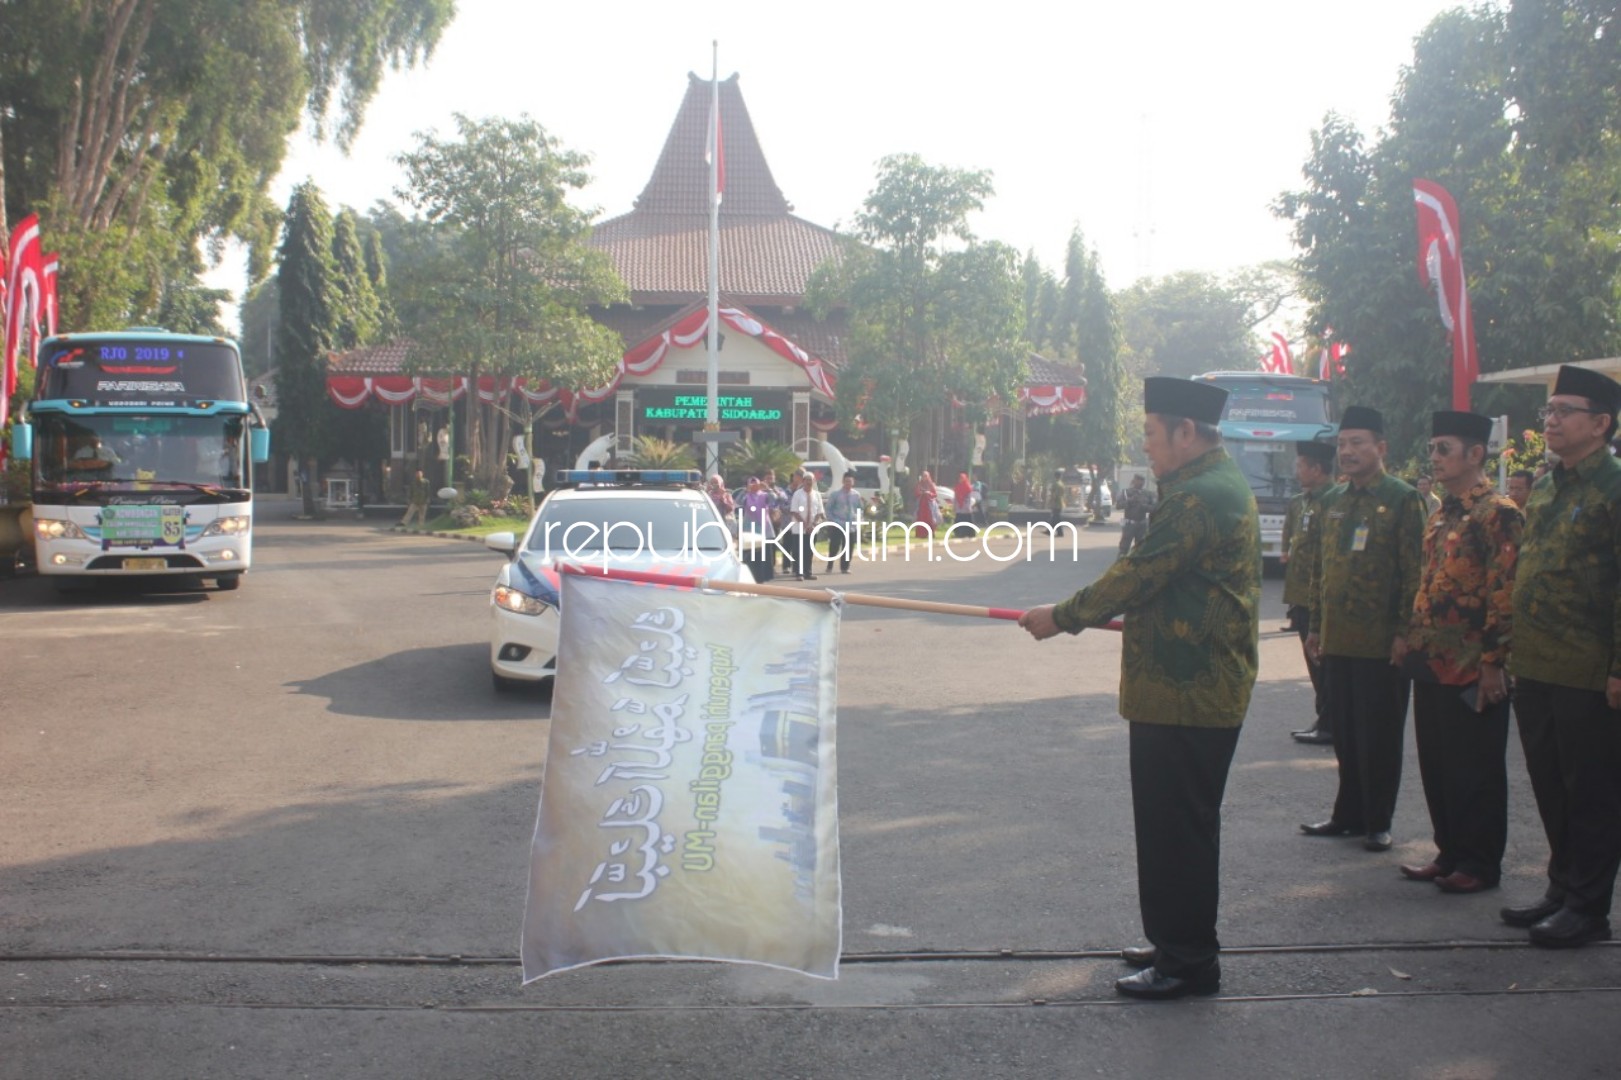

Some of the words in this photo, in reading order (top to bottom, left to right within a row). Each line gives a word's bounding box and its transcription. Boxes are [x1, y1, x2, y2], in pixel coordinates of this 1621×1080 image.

[135, 346, 170, 360] 2019
[675, 396, 752, 407] PEMEINTAH
[646, 408, 718, 418] KABUPAT
[722, 409, 781, 420] SIDOARJO
[164, 521, 180, 536] 85
